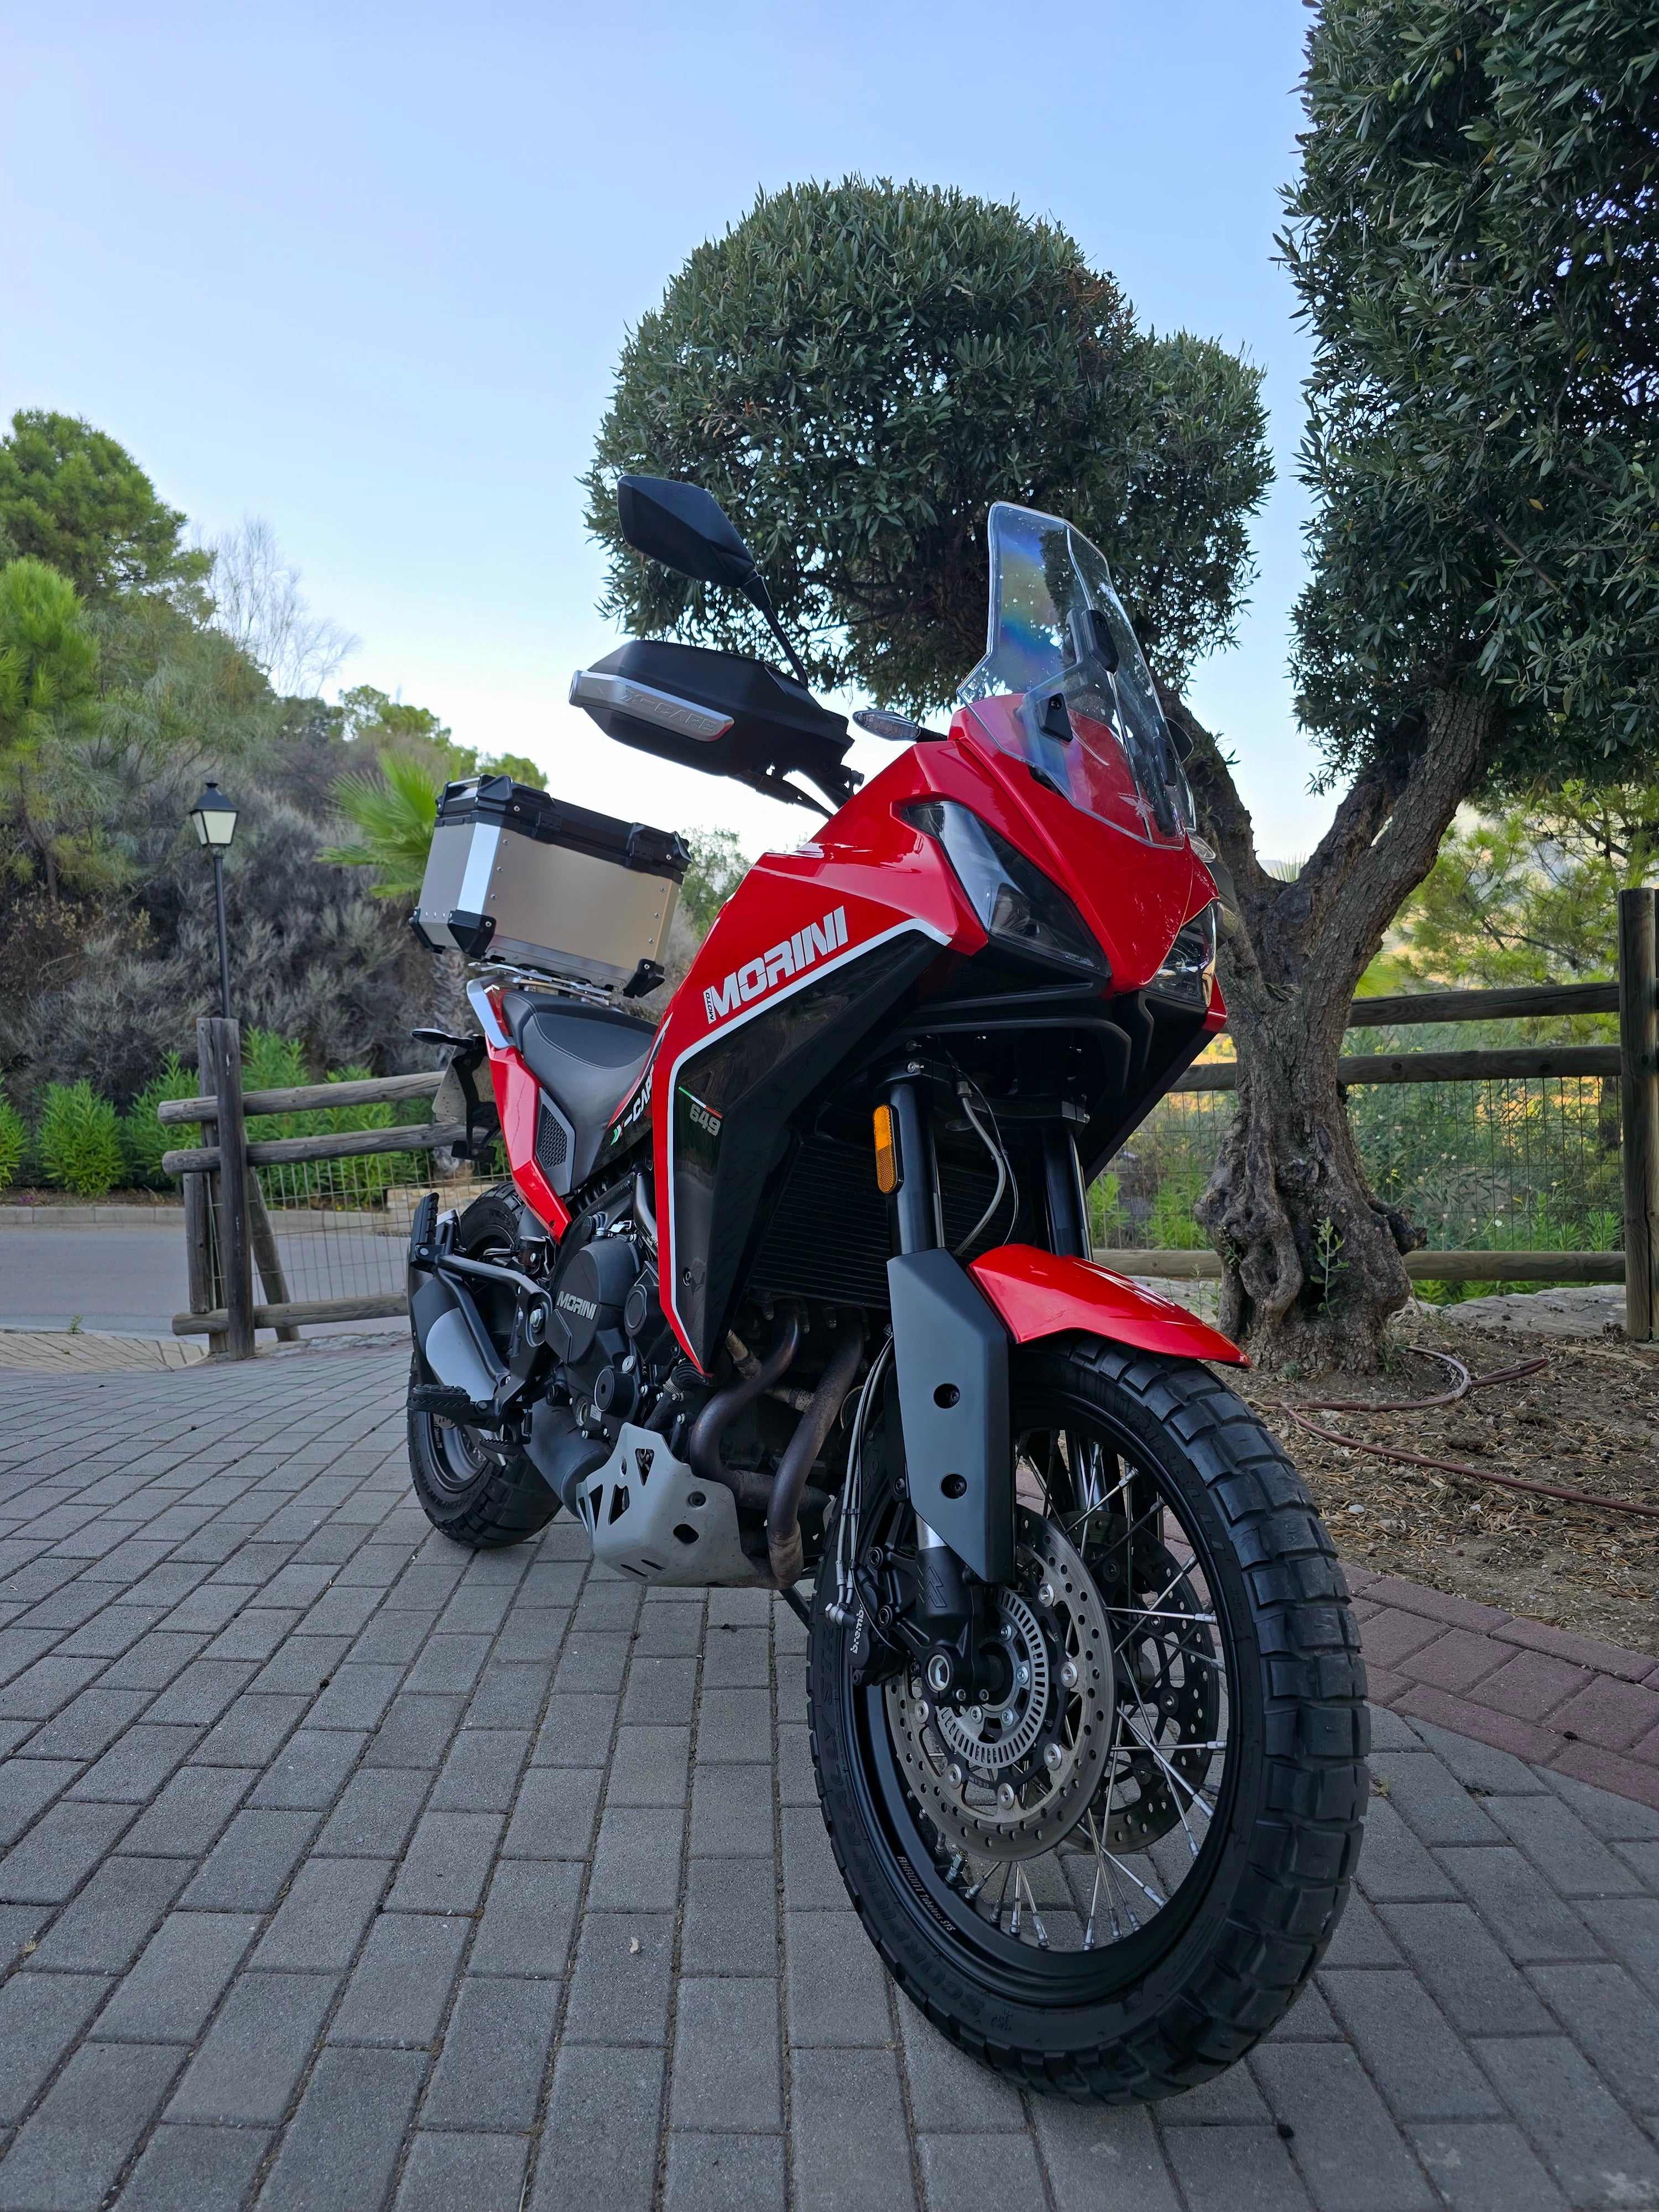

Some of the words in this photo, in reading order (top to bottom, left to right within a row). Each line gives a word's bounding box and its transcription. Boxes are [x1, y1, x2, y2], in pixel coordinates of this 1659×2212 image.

[619, 686, 717, 733] X-CAPE
[705, 992, 715, 1020] MOTO
[710, 905, 848, 1018] MORINI
[690, 1103, 721, 1136] 649
[556, 1291, 597, 1321] MORINI
[850, 1604, 864, 1654] bremb
[821, 1714, 860, 1845] RALLY
[919, 1893, 943, 1921] Tubeless
[854, 1857, 984, 2016] SCORPION
